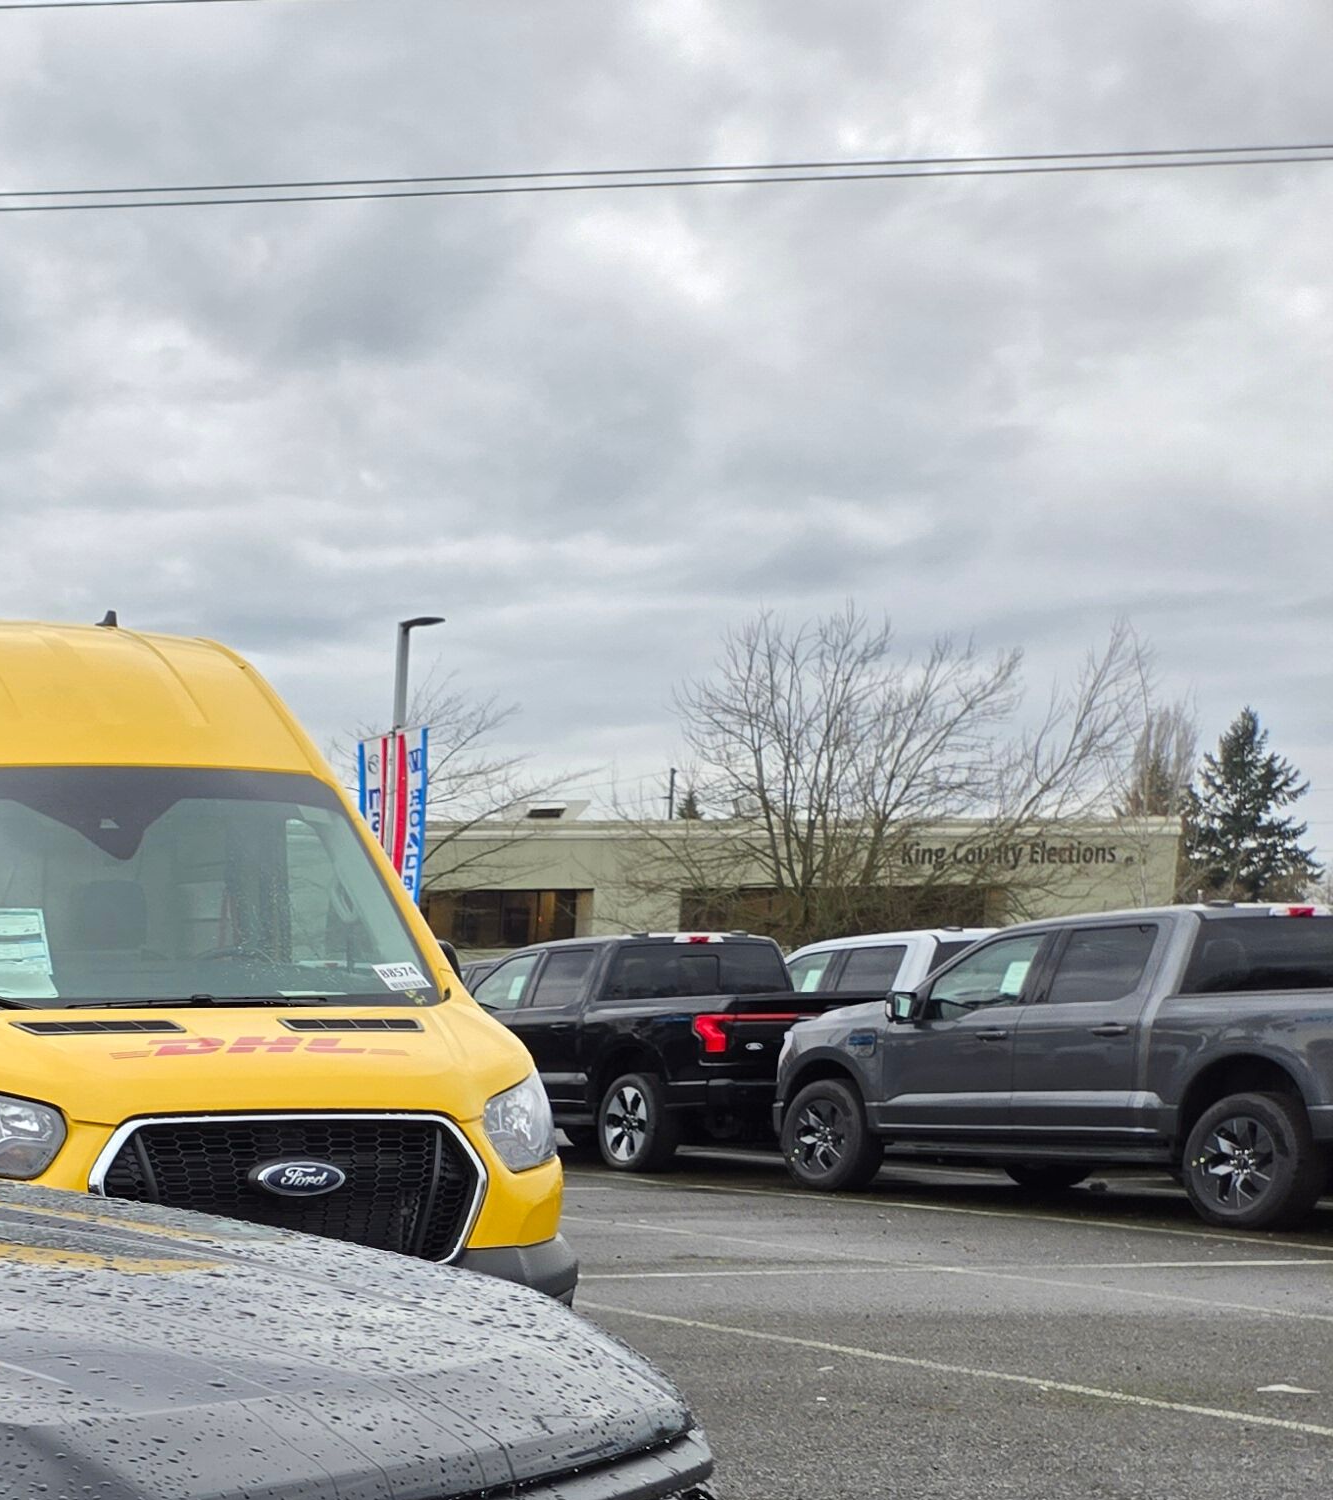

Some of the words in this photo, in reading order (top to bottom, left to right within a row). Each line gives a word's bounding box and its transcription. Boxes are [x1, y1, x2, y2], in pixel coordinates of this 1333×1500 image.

[901, 841, 944, 871] King
[954, 842, 1024, 870] County
[1028, 841, 1116, 865] Elections
[147, 1036, 366, 1057] DHL
[280, 1166, 328, 1186] Ford
